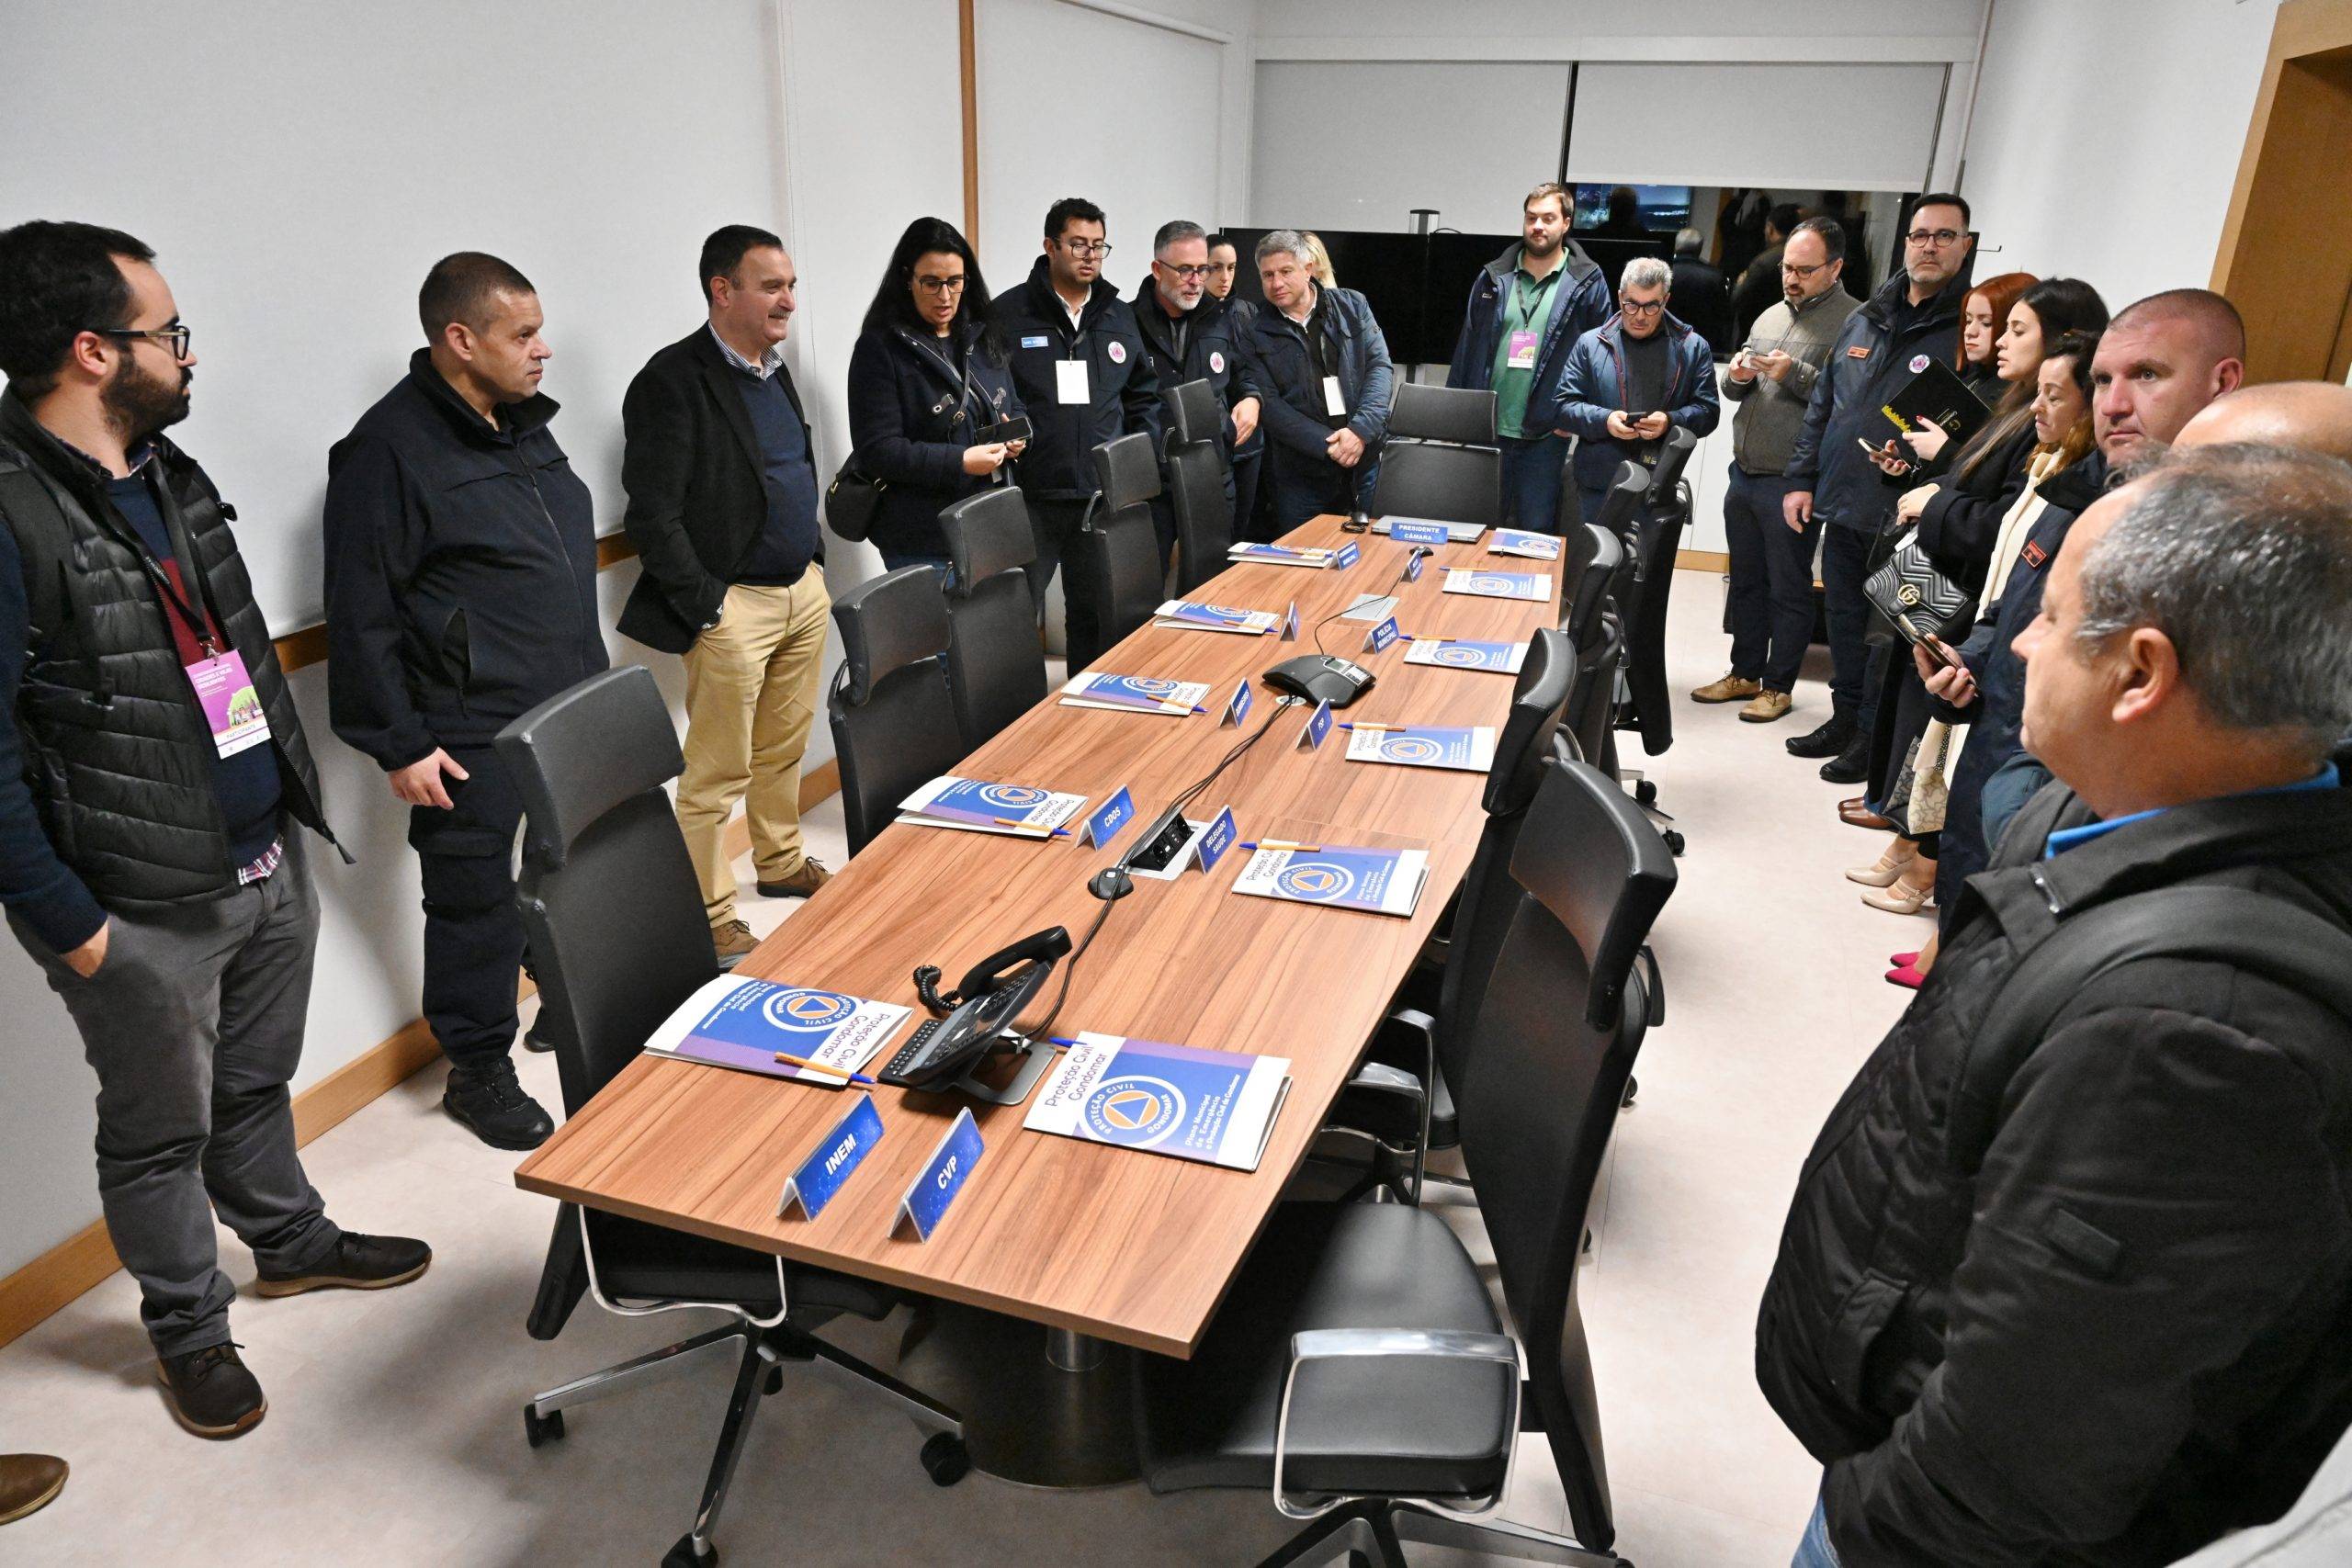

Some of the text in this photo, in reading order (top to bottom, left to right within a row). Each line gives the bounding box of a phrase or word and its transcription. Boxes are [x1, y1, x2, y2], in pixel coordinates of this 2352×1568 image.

[1398, 524, 1441, 534] PRESIDENTE
[1104, 806, 1122, 828] CDOS
[1205, 819, 1227, 849] DELEGADO
[804, 1018, 832, 1026] CIVIL
[821, 1015, 868, 1058] Gondomar
[831, 1013, 890, 1069] Proteção Civil
[1044, 1045, 1094, 1107] Proteção Civil
[1069, 1053, 1107, 1100] Gondomar
[1091, 1083, 1136, 1134] PROTEÇÃO CIVIL
[1147, 1093, 1172, 1134] GONDOMAR
[1185, 1094, 1211, 1146] Plano Municipal
[1199, 1096, 1221, 1134] Emergência
[825, 1133, 856, 1176] INEM
[938, 1155, 957, 1190] CVP
